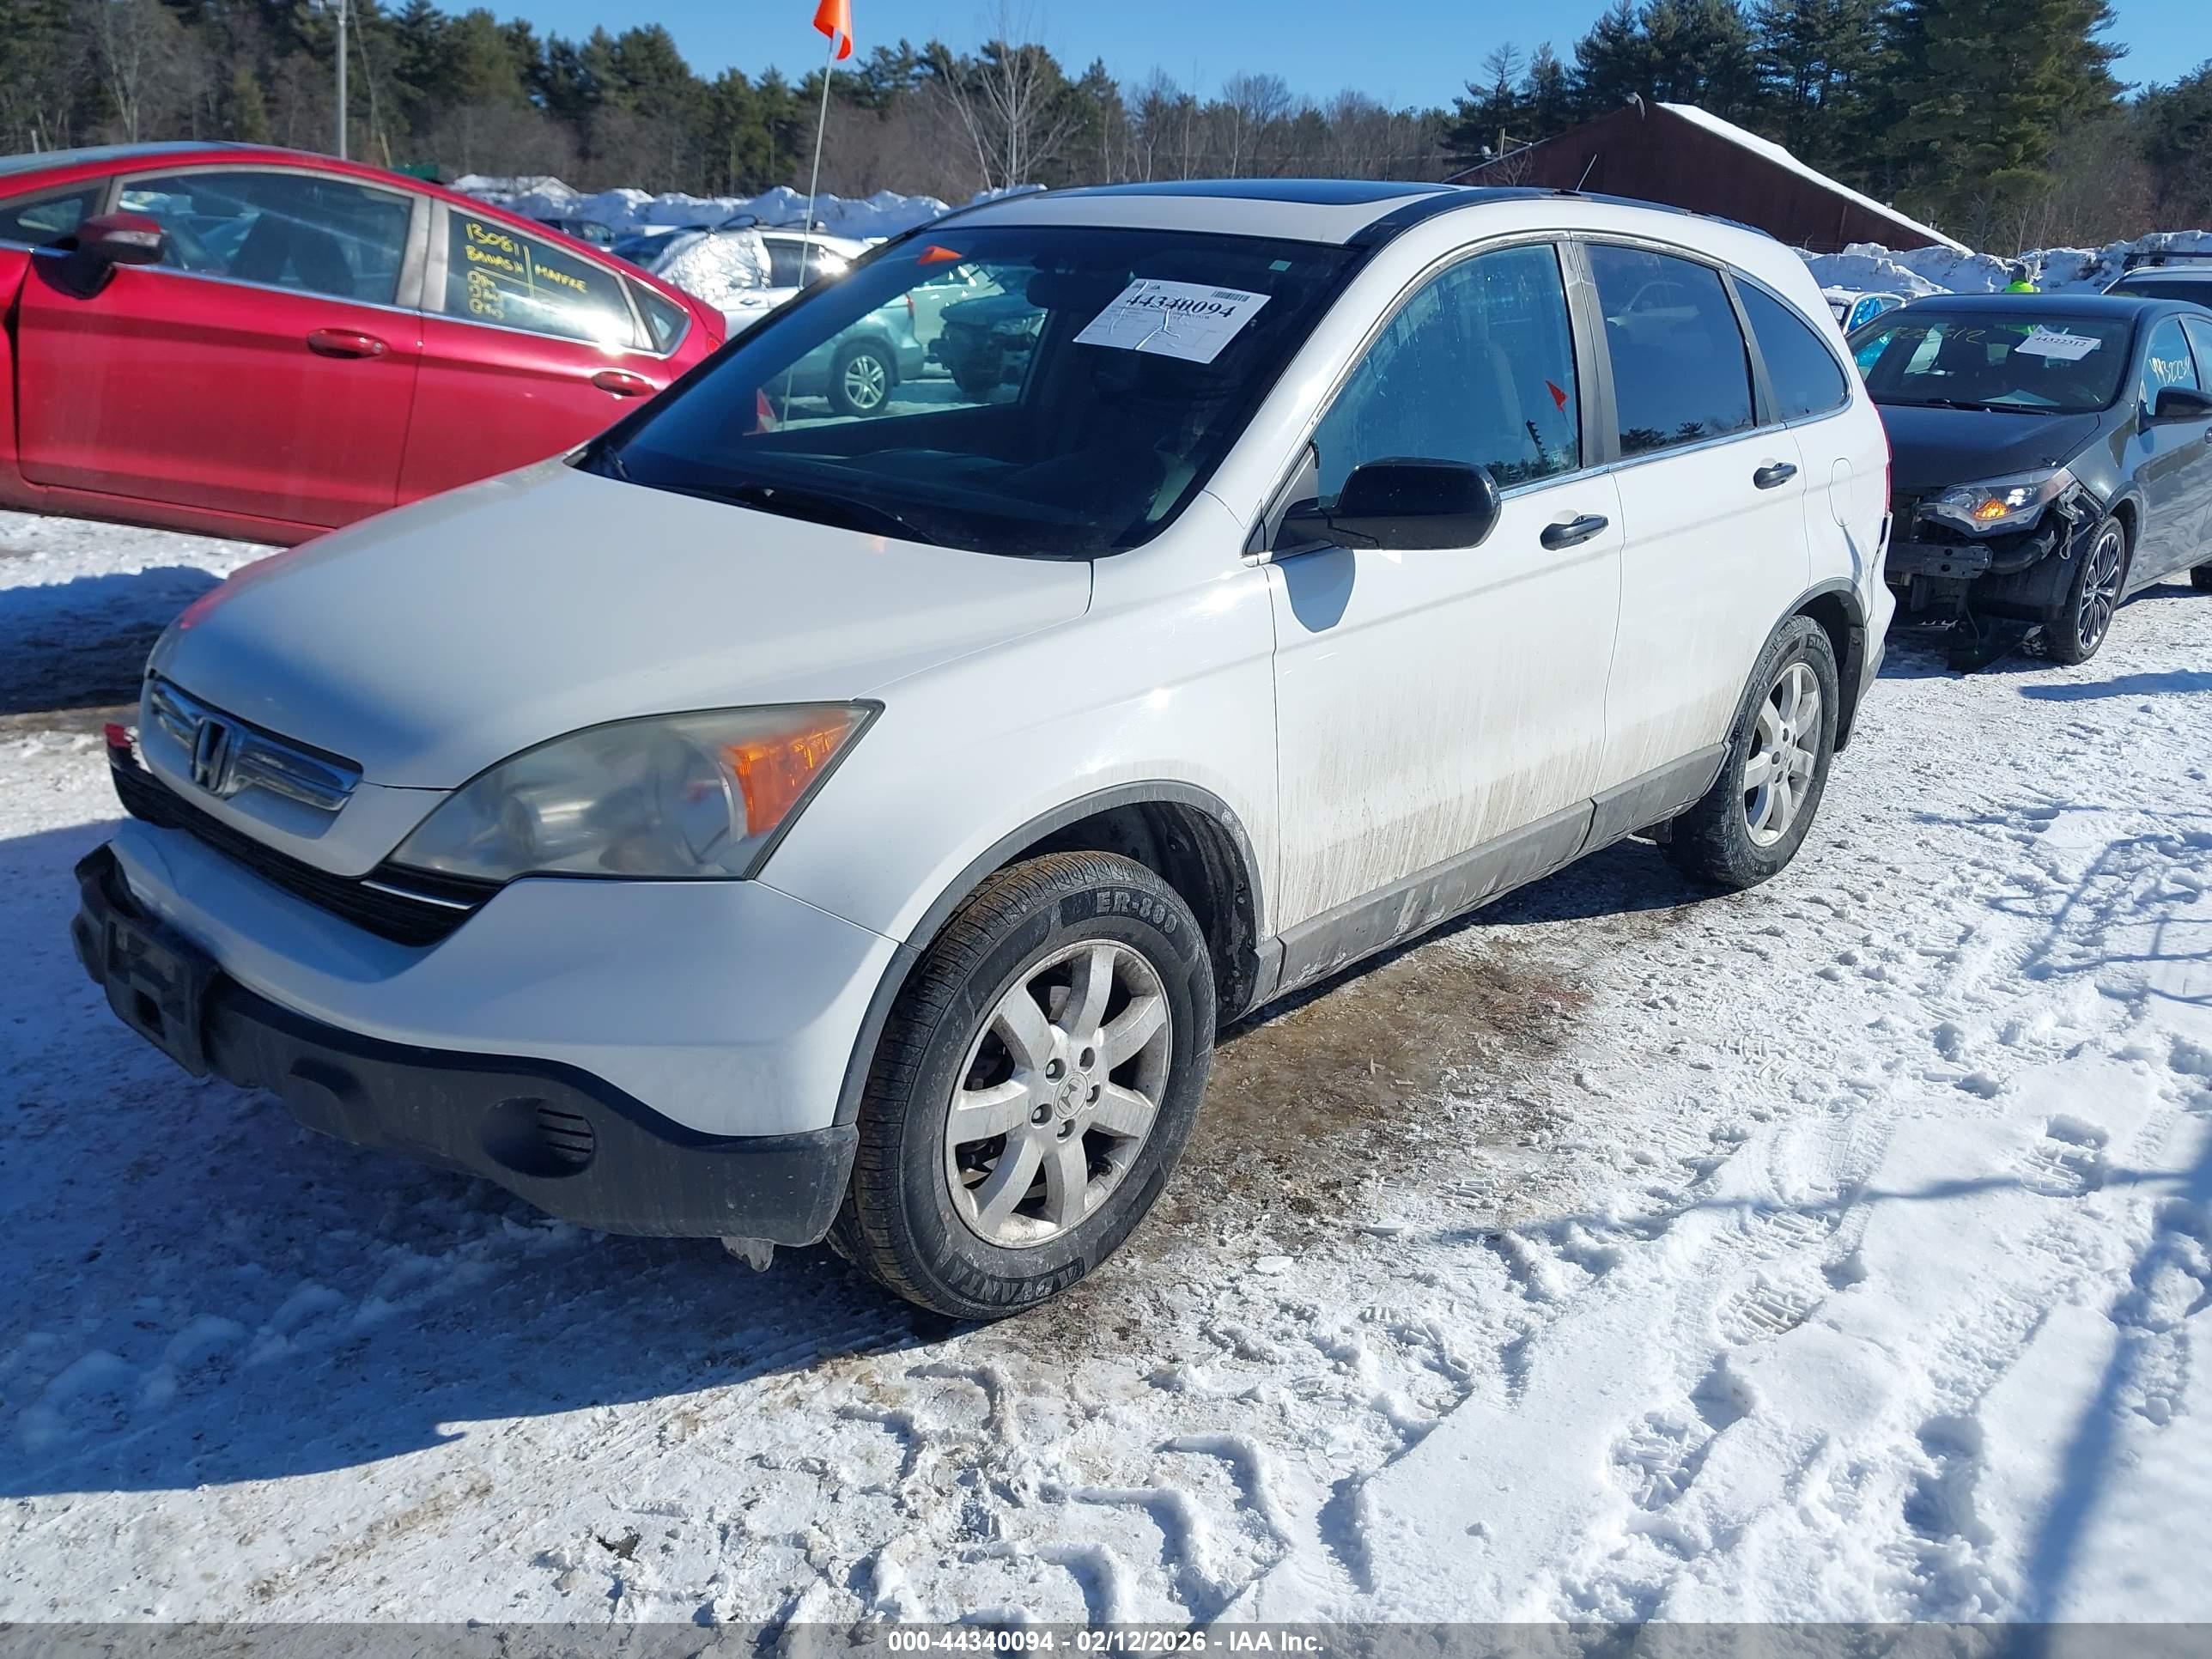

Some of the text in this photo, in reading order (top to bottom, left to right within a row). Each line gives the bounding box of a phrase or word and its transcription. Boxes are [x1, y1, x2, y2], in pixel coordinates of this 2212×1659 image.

[466, 223, 520, 256] 13081
[1126, 294, 1237, 319] 44340094
[1096, 890, 1178, 934] ER-800
